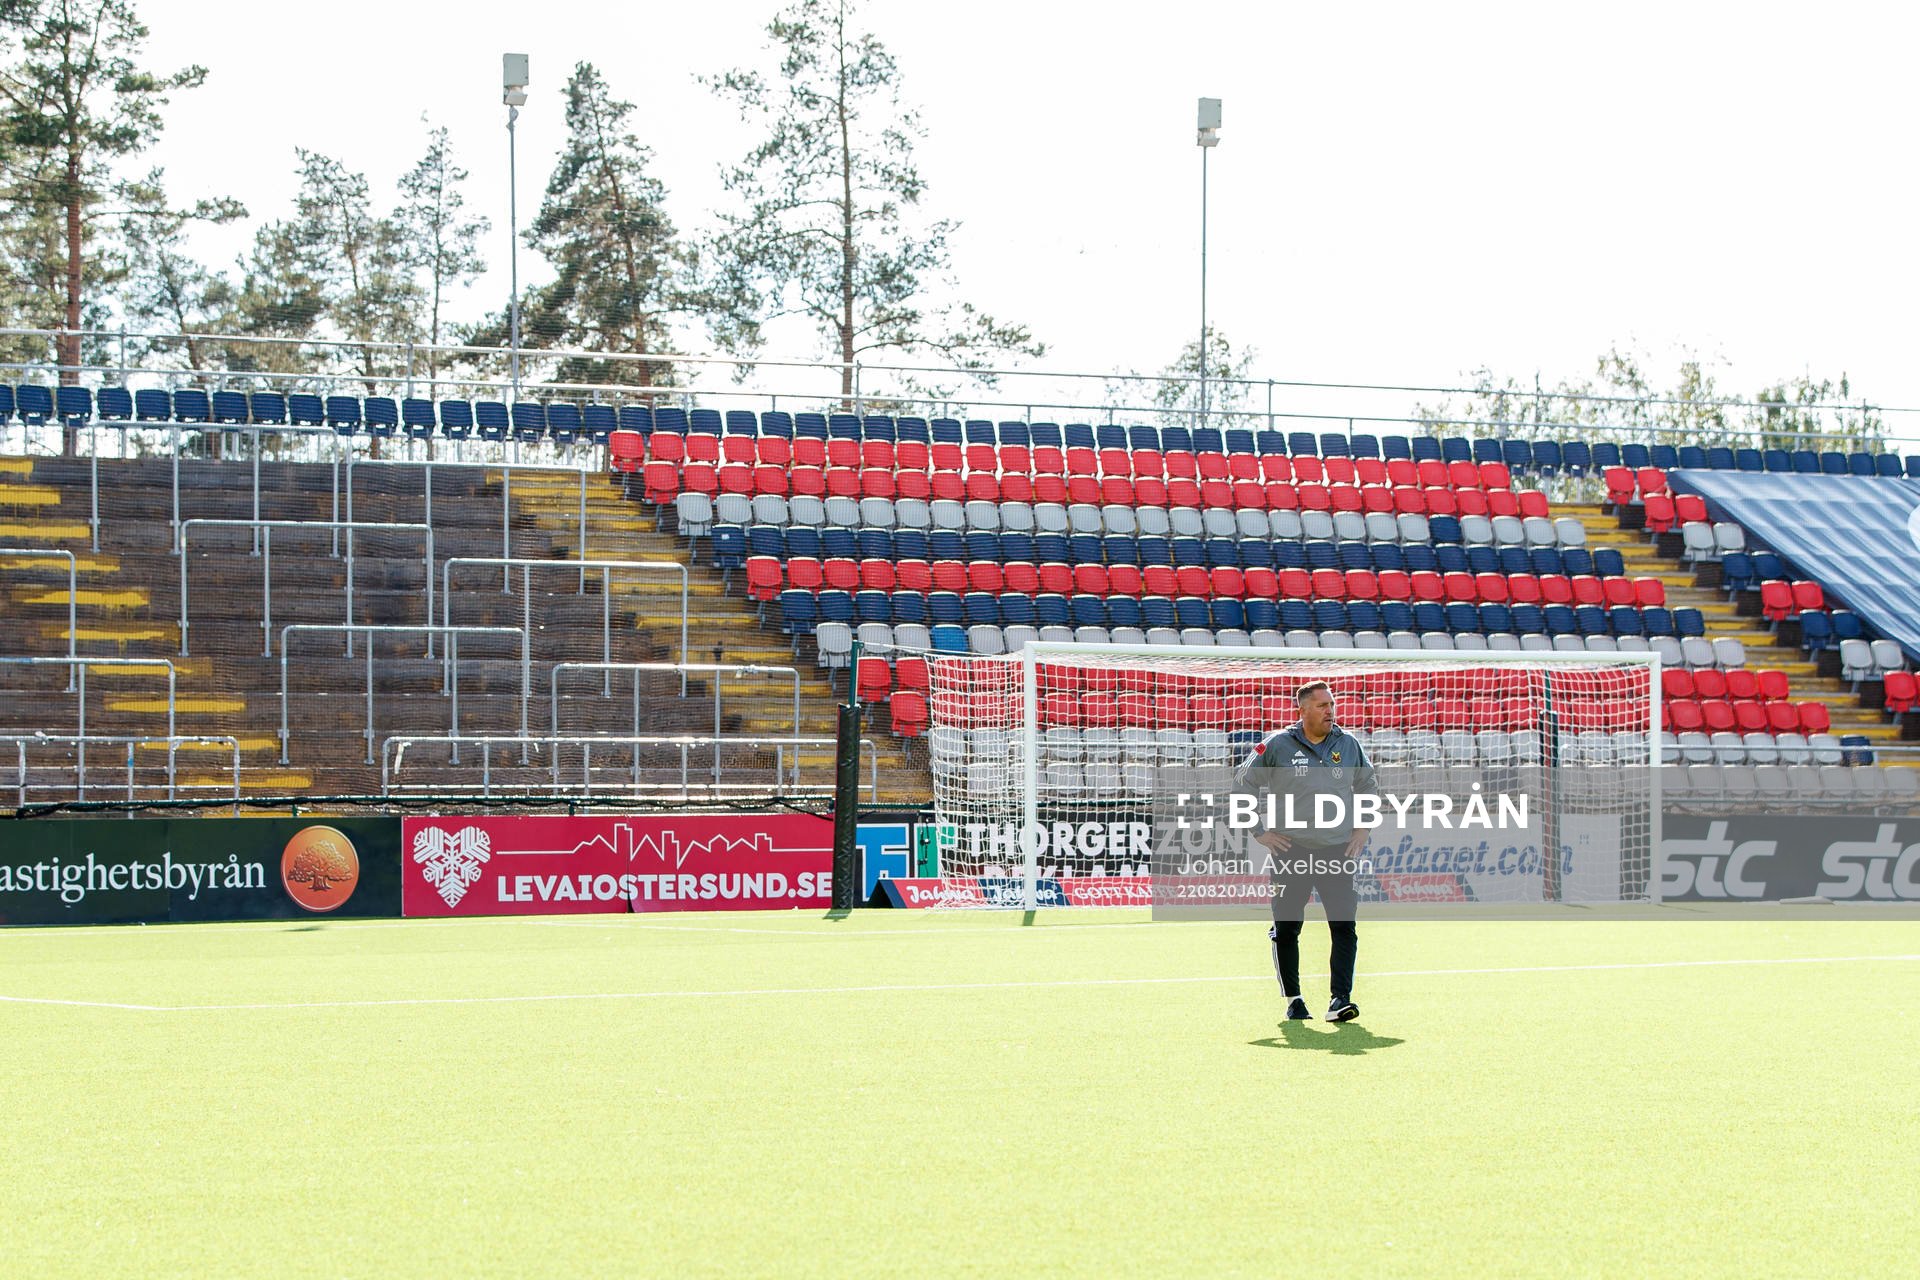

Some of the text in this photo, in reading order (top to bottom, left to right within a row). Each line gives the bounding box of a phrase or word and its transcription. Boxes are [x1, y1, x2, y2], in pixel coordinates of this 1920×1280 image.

[1294, 765, 1309, 777] MP
[965, 820, 1243, 858] THORGERZON
[1644, 820, 1778, 898] stc
[0, 851, 266, 904] astighetsbyrån
[497, 872, 833, 903] LEVAIOSTERSUND.SE
[1074, 886, 1121, 899] GOTT
